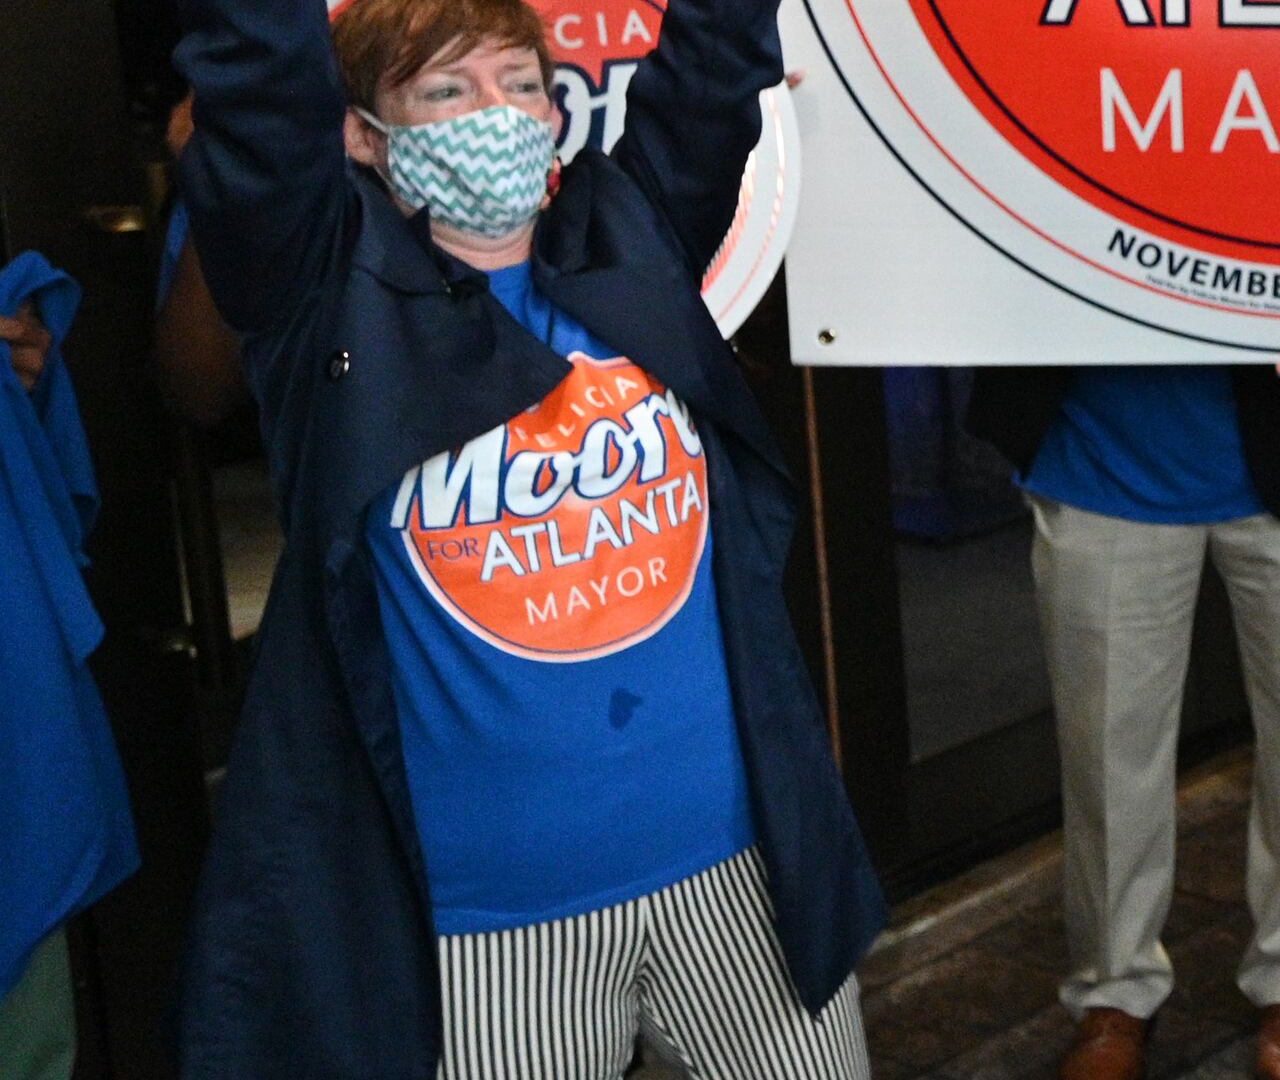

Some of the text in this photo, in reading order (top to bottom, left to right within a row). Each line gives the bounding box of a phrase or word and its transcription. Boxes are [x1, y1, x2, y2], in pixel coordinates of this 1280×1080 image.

[428, 470, 703, 583] FOR ATLANTA
[525, 557, 668, 626] MAYOR
